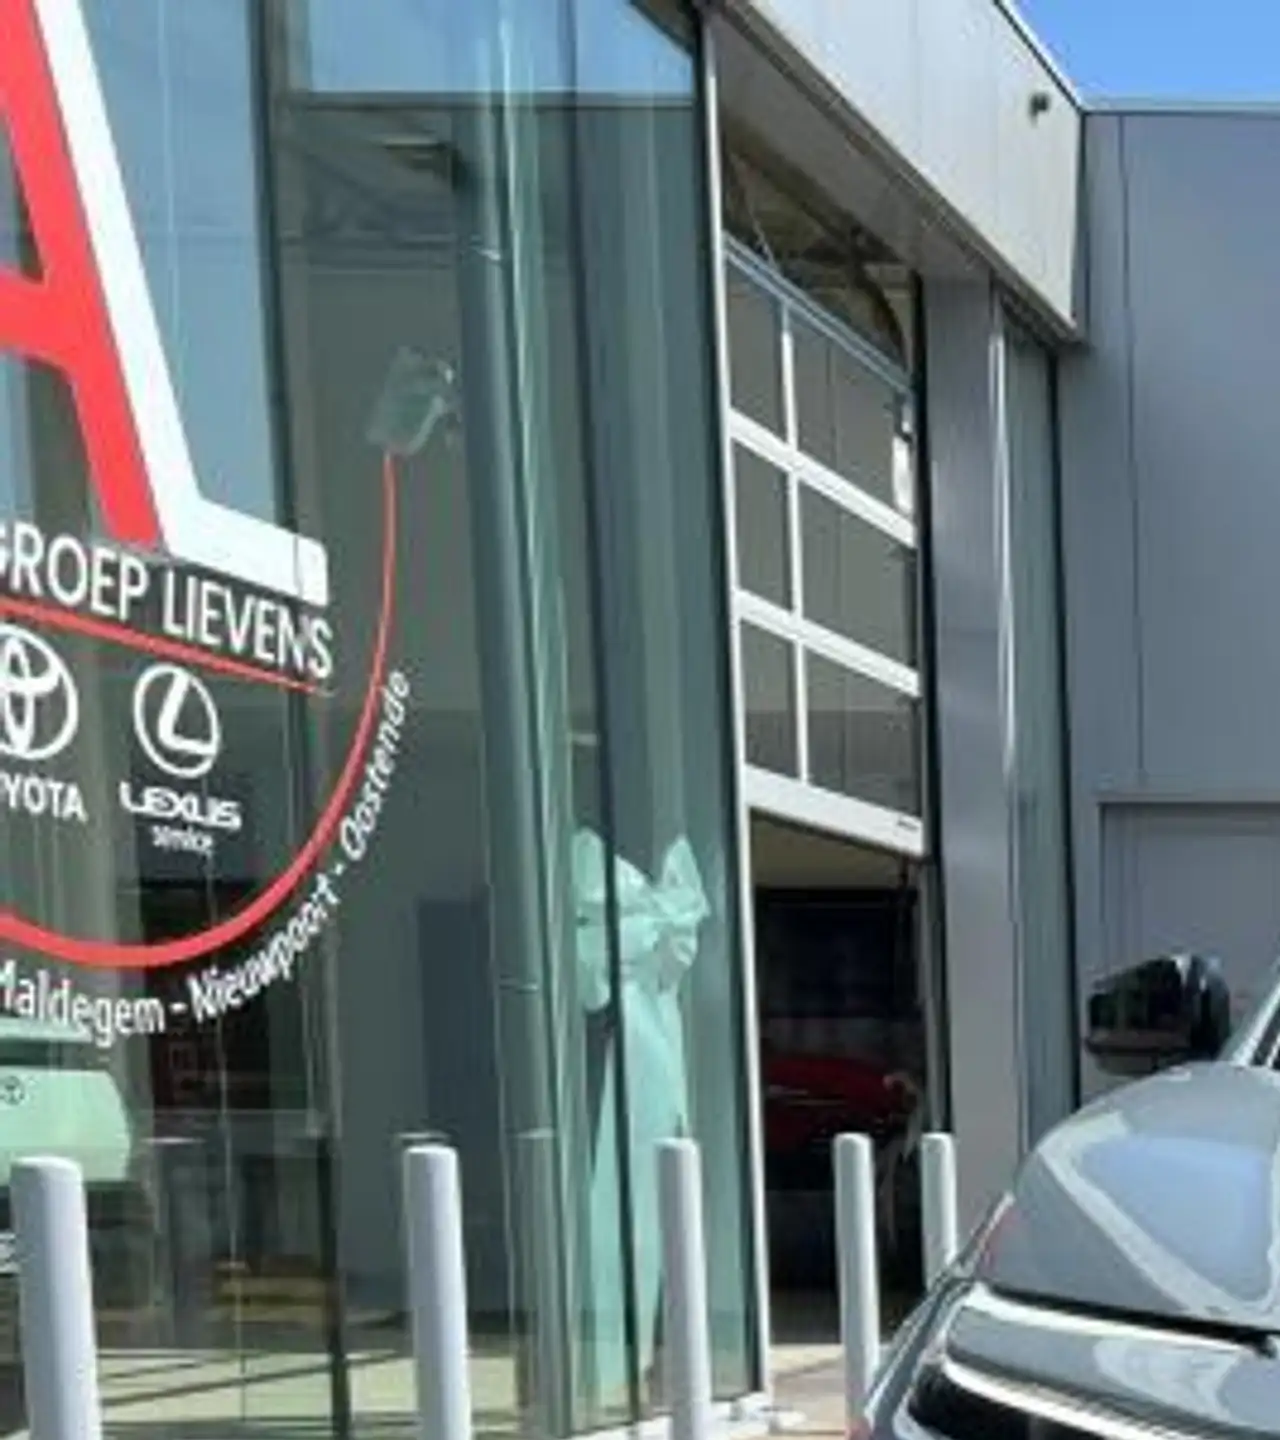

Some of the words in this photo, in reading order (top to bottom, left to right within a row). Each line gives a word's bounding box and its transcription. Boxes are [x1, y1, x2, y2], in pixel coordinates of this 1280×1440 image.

[0, 521, 150, 620] ROEP
[162, 567, 334, 679] LIEVENS
[0, 770, 87, 822] YOTA
[118, 782, 242, 830] LEXUS
[186, 871, 341, 1022] Nieuwpoort
[339, 670, 411, 861] Oostende
